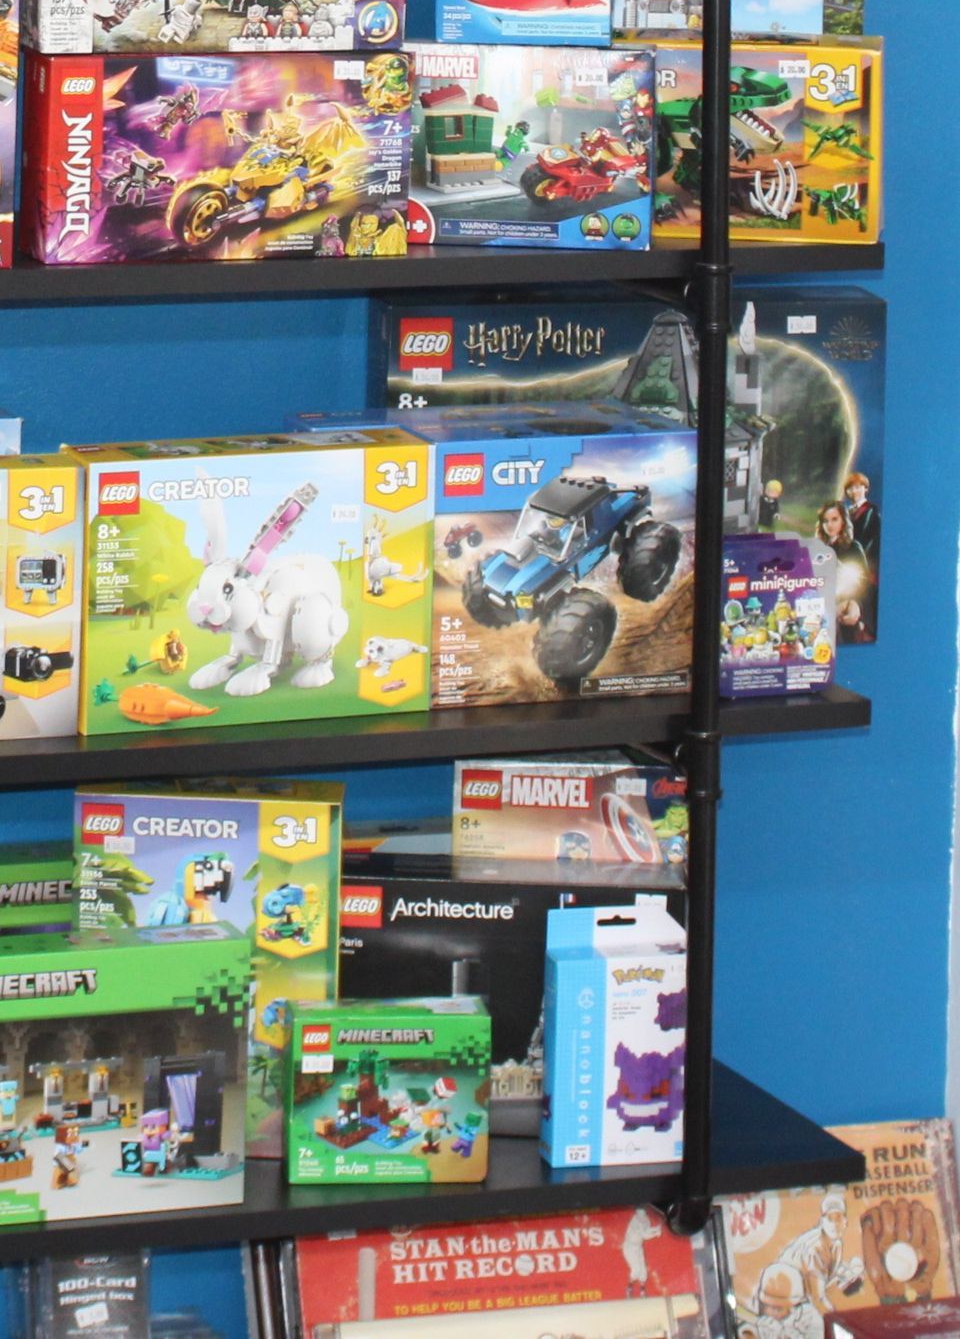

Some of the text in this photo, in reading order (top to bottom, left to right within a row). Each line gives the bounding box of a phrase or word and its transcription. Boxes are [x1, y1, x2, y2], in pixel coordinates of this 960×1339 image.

[50, 4, 85, 18] pcs/pzs
[422, 56, 478, 78] MARVEL
[62, 77, 96, 95] LEGO
[384, 121, 402, 135] 7+
[60, 110, 94, 237] NINJAGO
[387, 171, 401, 181] 137
[368, 181, 401, 196] pcs/pzs
[460, 222, 500, 230] WARNING:
[402, 317, 606, 367] LEGO Harry Potter
[398, 393, 428, 408] 8+
[446, 459, 546, 486] LEGO CITY
[100, 477, 250, 503] LEGO CREATOR
[97, 524, 120, 539] 8+
[97, 562, 114, 573] 258
[96, 573, 129, 588] pcs/pzs
[750, 576, 825, 592] minifigures
[441, 617, 463, 631] 5+
[439, 654, 456, 665] 148
[439, 664, 472, 677] pcs/pzs
[463, 776, 591, 808] LEGO MARVEL
[84, 815, 238, 839] LEGO CREATOR
[460, 817, 481, 831] 8+
[81, 853, 101, 867] 7+
[80, 889, 97, 900] 253
[343, 896, 514, 922] LEGO Architecture
[304, 1028, 434, 1044] LEGO MINECRAFT
[299, 1148, 312, 1159] 7+
[873, 1143, 926, 1163] RUN
[866, 1163, 928, 1180] ASEBALL
[853, 1180, 934, 1199] DISPENSER
[392, 1252, 578, 1284] HIT RECORD
[58, 1276, 137, 1292] 100-Card
[60, 1292, 134, 1306] Hinged box
[394, 1306, 409, 1316] TO
[412, 1303, 440, 1314] HELP
[443, 1301, 464, 1312] YOU
[468, 1299, 481, 1310] BE
[486, 1300, 494, 1309] A
[519, 1294, 558, 1305] LEAGUE
[563, 1290, 602, 1303] BATTER
